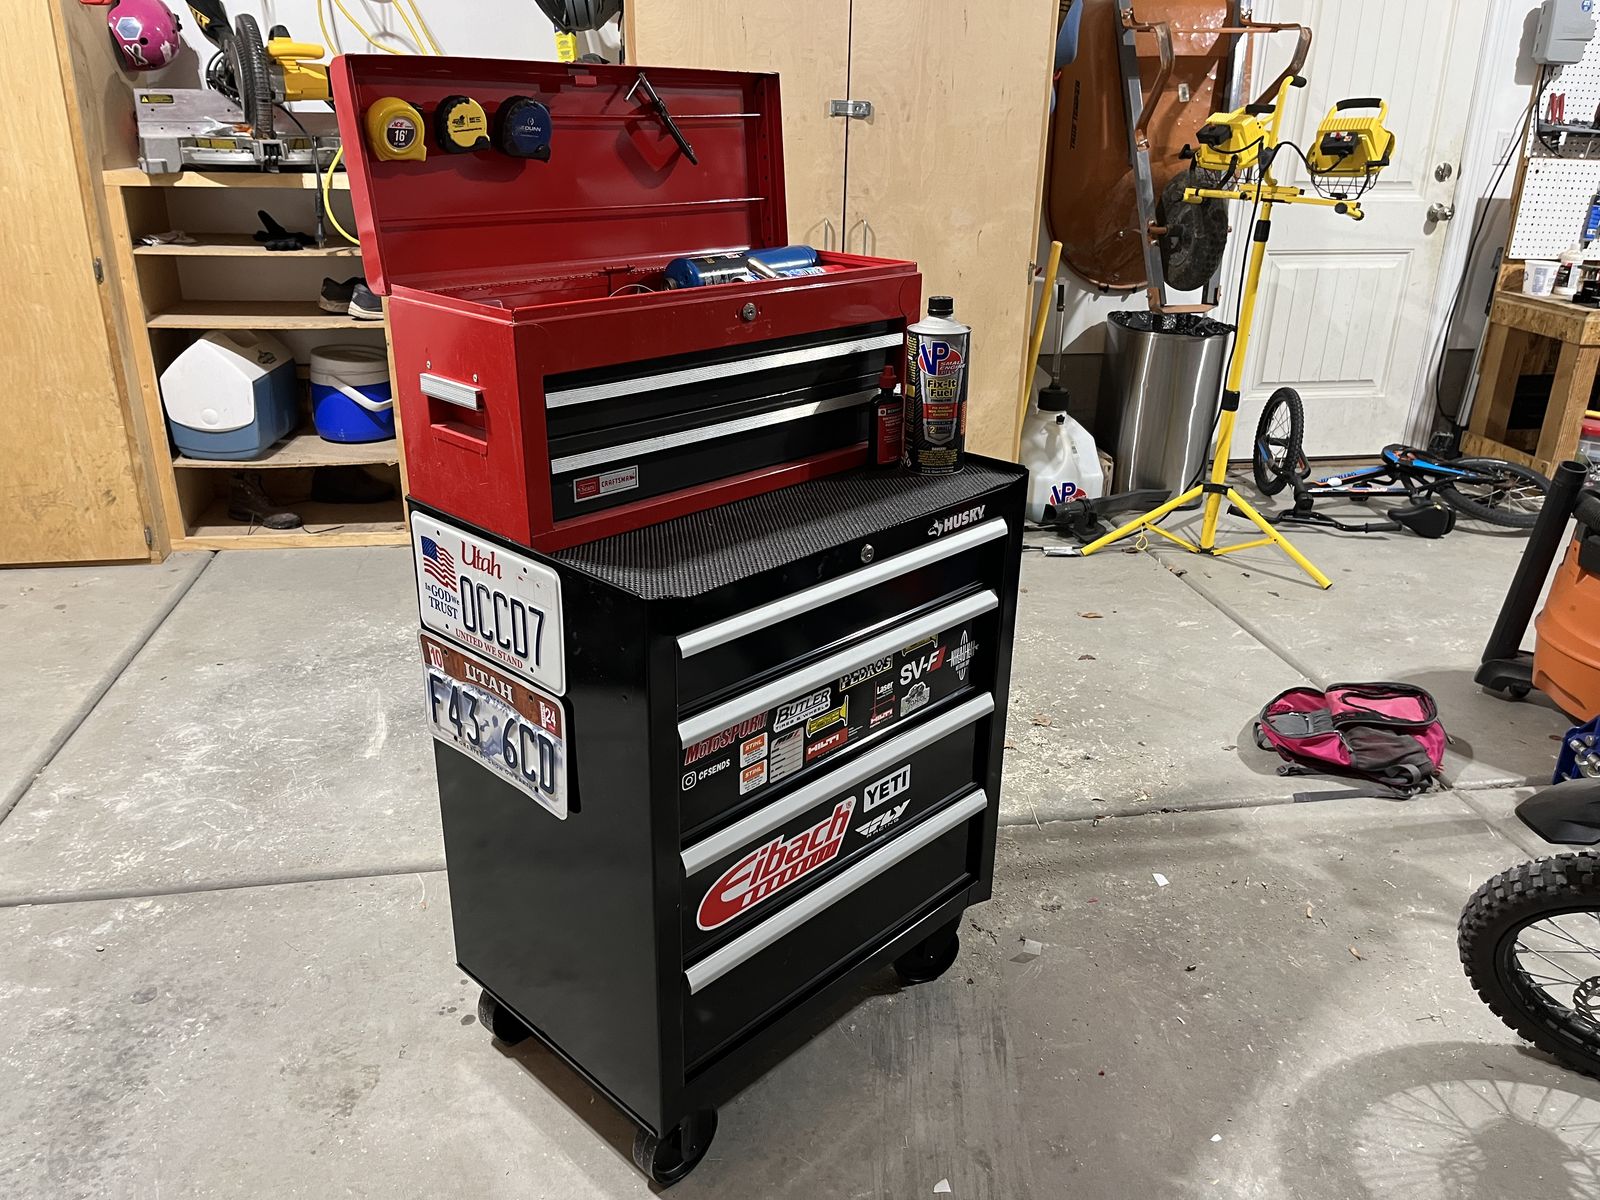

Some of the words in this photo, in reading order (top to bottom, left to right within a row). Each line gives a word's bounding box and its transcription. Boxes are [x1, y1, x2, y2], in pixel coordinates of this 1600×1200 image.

[394, 129, 408, 142] 16'
[920, 341, 950, 376] VP
[930, 388, 953, 397] Fuel
[601, 475, 635, 487] CRAFTSMAN
[1051, 482, 1077, 504] VP
[943, 504, 986, 532] HUSKY
[460, 540, 502, 580] Utah
[431, 585, 451, 602] GOD
[428, 596, 458, 619] TRUST
[430, 648, 443, 669] 10
[455, 628, 483, 648] UNITED
[484, 643, 497, 656] WE
[497, 649, 523, 669] STAND
[841, 655, 892, 689] PEDRO'S
[900, 650, 939, 686] SV-F
[464, 661, 514, 705] UTAH
[876, 681, 894, 695] Laser
[545, 707, 557, 727] 24
[775, 690, 829, 725] BUTLER
[429, 674, 480, 746] F43
[502, 718, 555, 795] 6CD
[744, 739, 762, 752] STIHL
[807, 733, 840, 755] HILTI
[698, 759, 731, 781] CFSENDS
[744, 765, 762, 778] STIHL
[866, 770, 908, 806] YETI
[856, 799, 911, 837] FLY
[699, 803, 852, 928] Eibach
